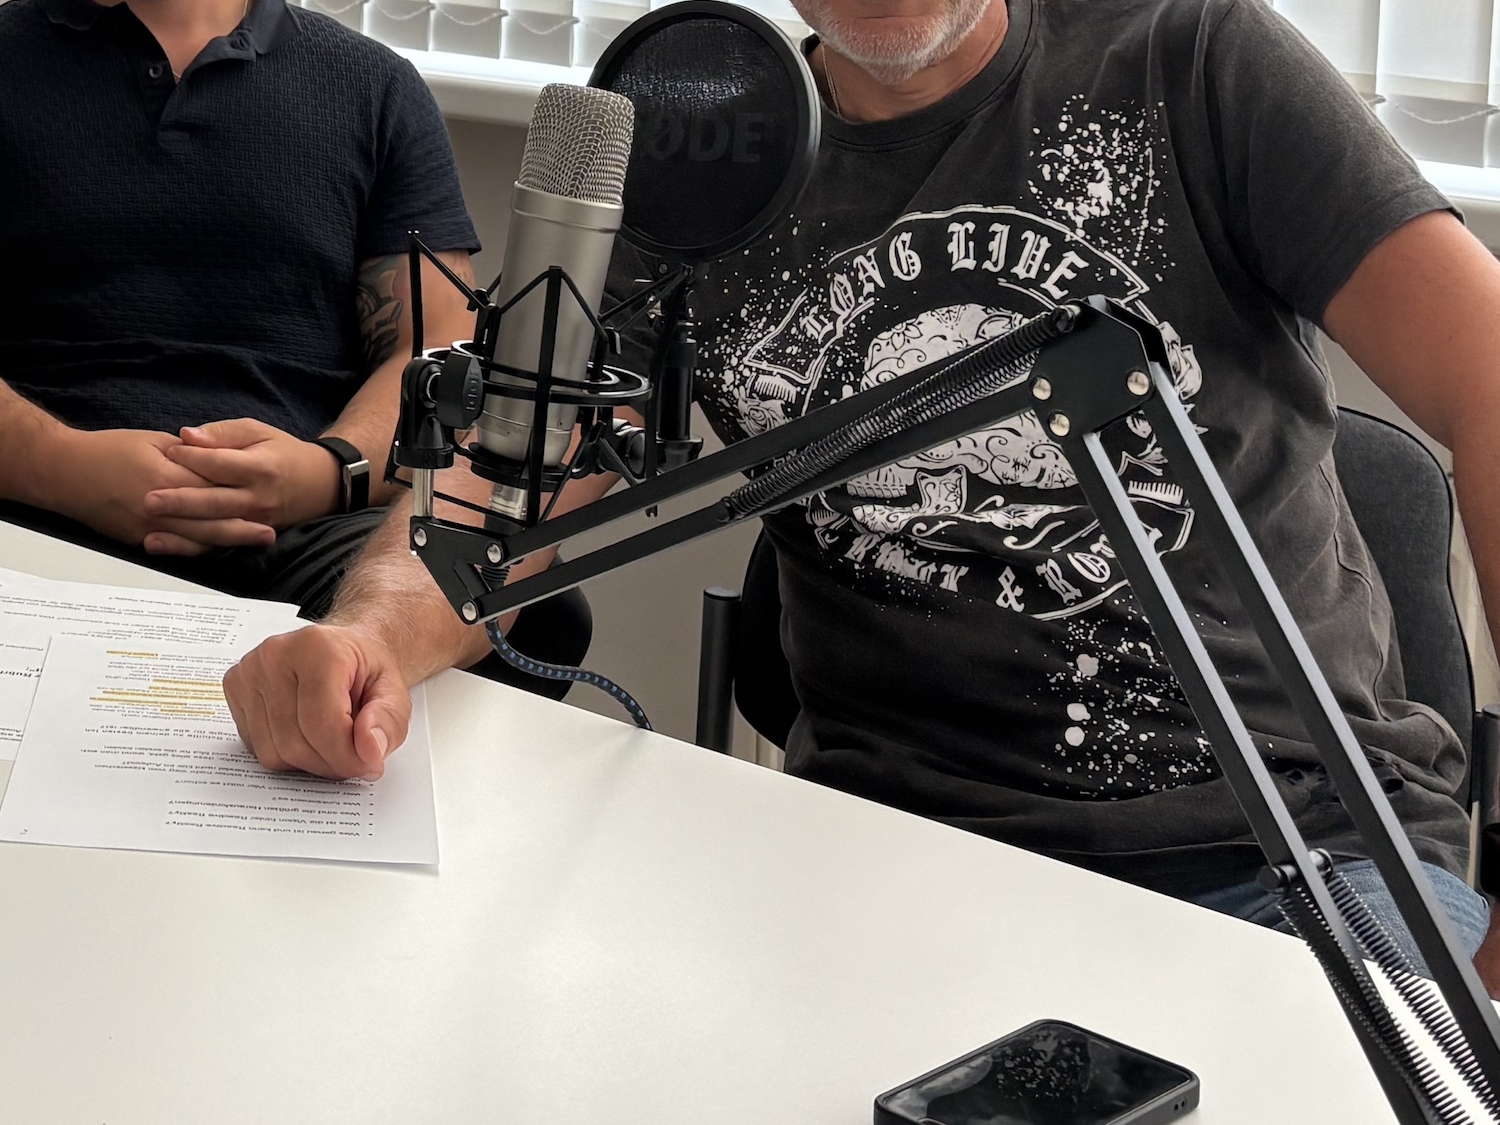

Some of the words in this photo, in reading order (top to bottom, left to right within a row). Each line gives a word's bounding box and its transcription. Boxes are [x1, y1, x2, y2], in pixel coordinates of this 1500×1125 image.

[638, 112, 766, 163] ØDE
[801, 231, 922, 344] LONG
[947, 221, 1089, 300] LIVE
[996, 566, 1024, 613] &
